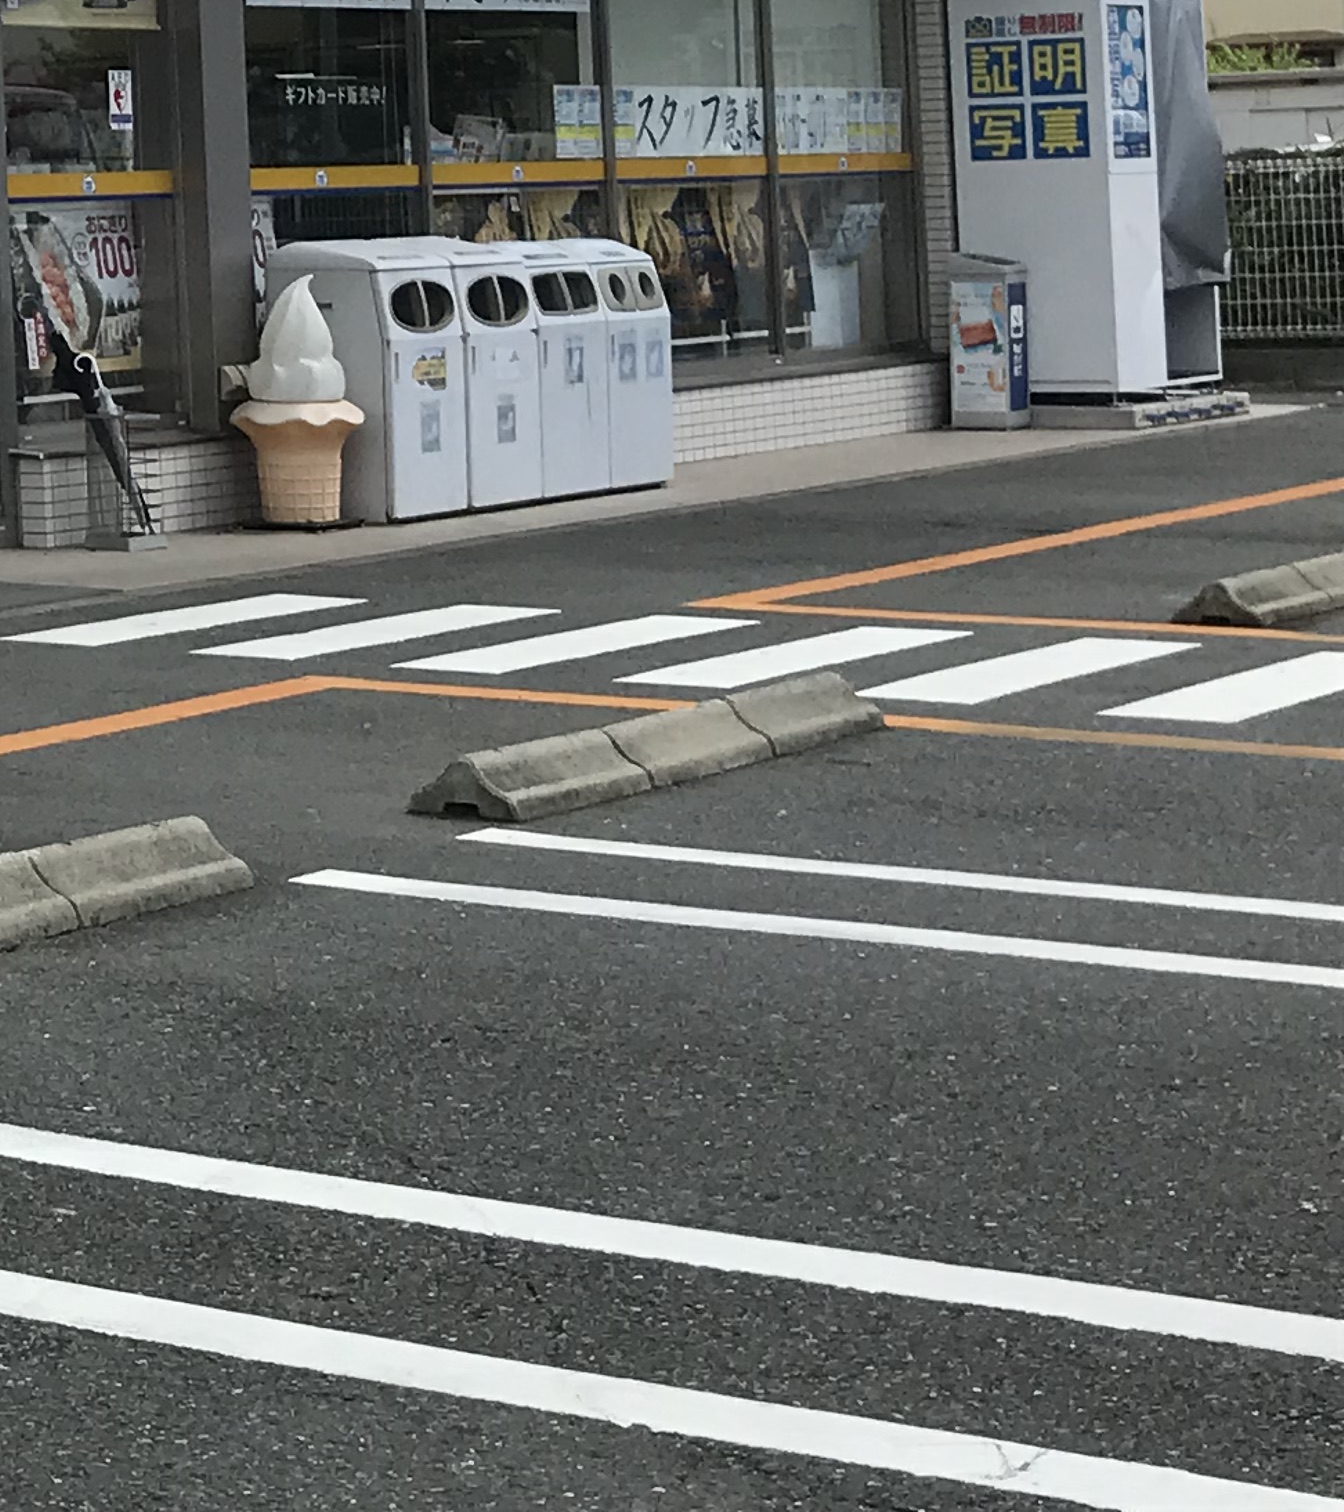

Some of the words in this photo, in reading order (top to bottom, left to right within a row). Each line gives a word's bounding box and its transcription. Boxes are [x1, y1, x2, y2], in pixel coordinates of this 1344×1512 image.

[970, 41, 1082, 94] 証明
[972, 105, 1084, 157] 写真
[88, 235, 135, 280] 100
